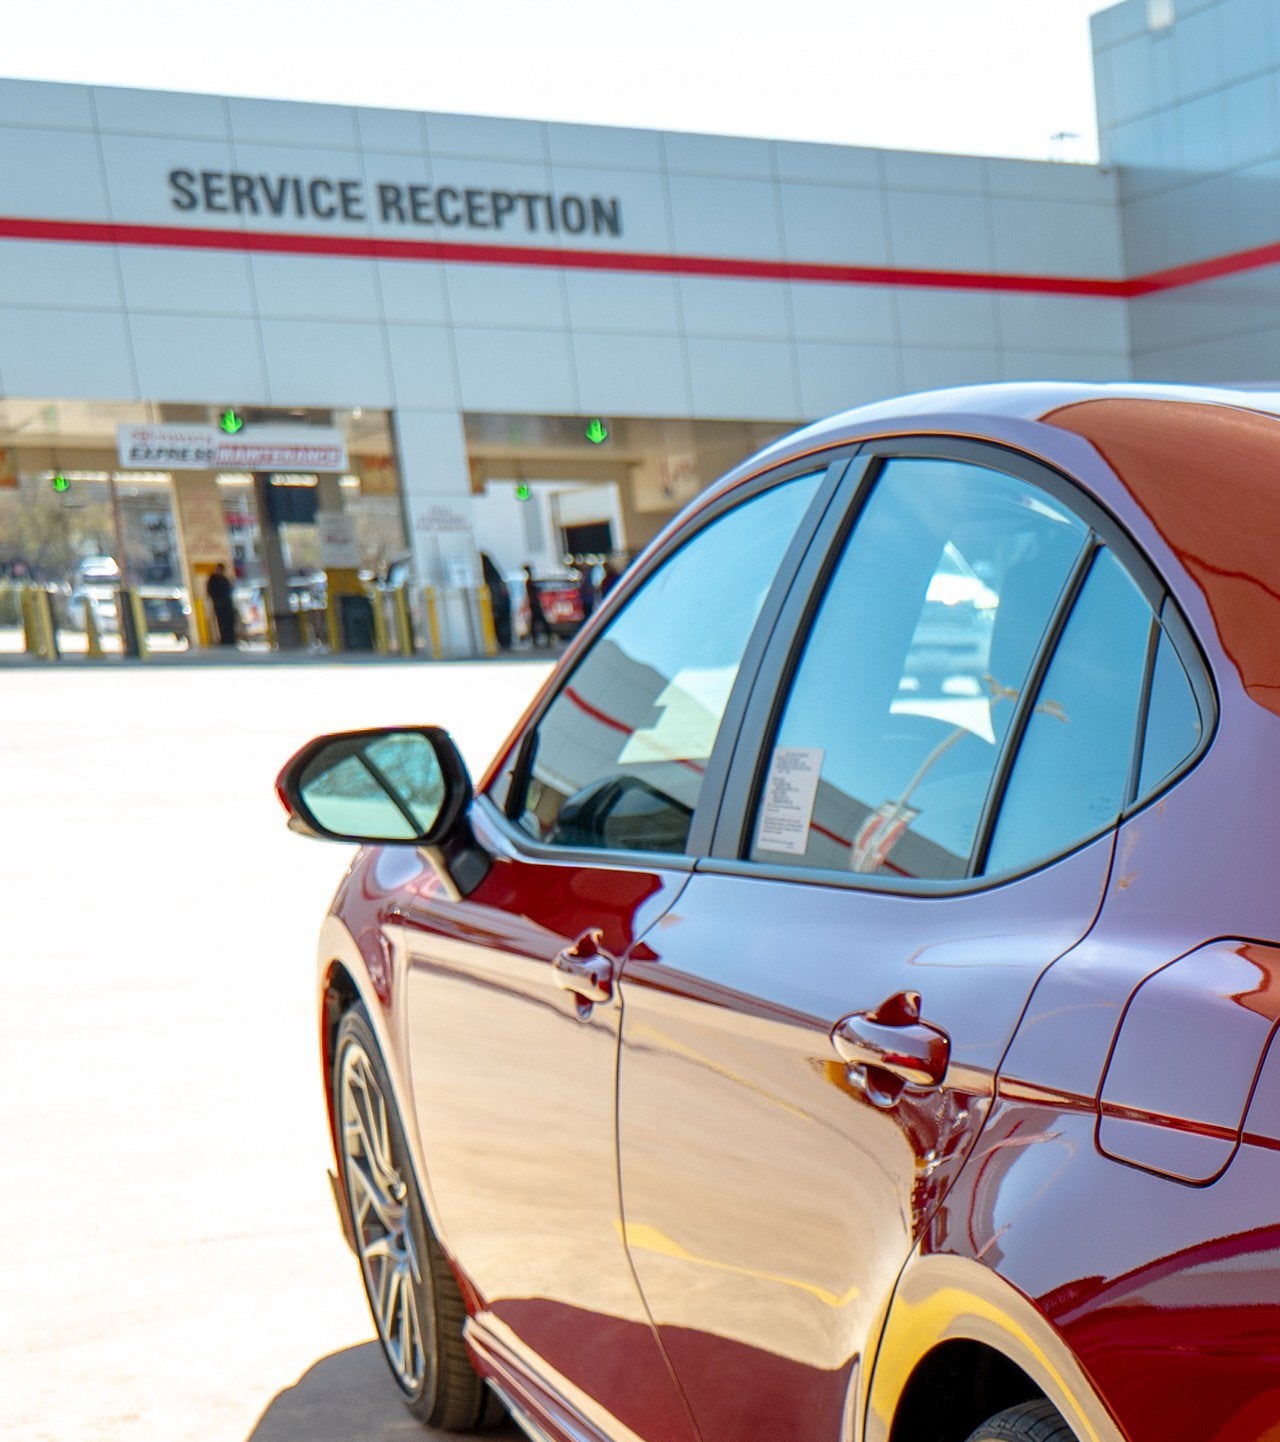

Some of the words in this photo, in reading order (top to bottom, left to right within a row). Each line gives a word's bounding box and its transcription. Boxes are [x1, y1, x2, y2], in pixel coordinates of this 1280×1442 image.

[168, 169, 365, 223] SERVICE
[376, 182, 625, 238] RECEPTION
[129, 445, 216, 463] EXPRESS
